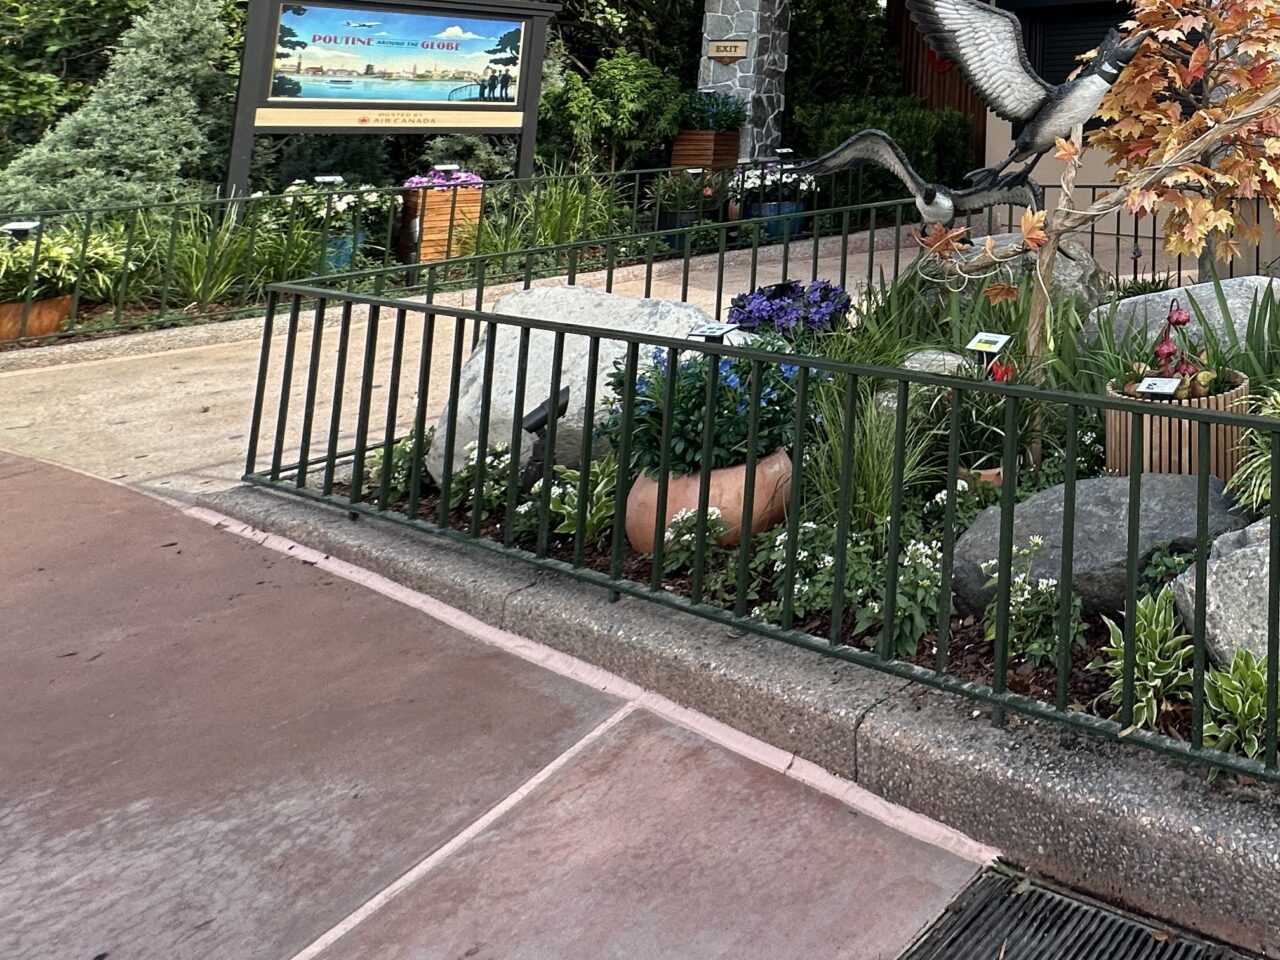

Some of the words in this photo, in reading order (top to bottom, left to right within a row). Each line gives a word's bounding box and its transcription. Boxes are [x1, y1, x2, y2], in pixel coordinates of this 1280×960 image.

[311, 34, 374, 46] POUTINE
[421, 41, 462, 51] GLOBE
[715, 45, 739, 53] EXIT
